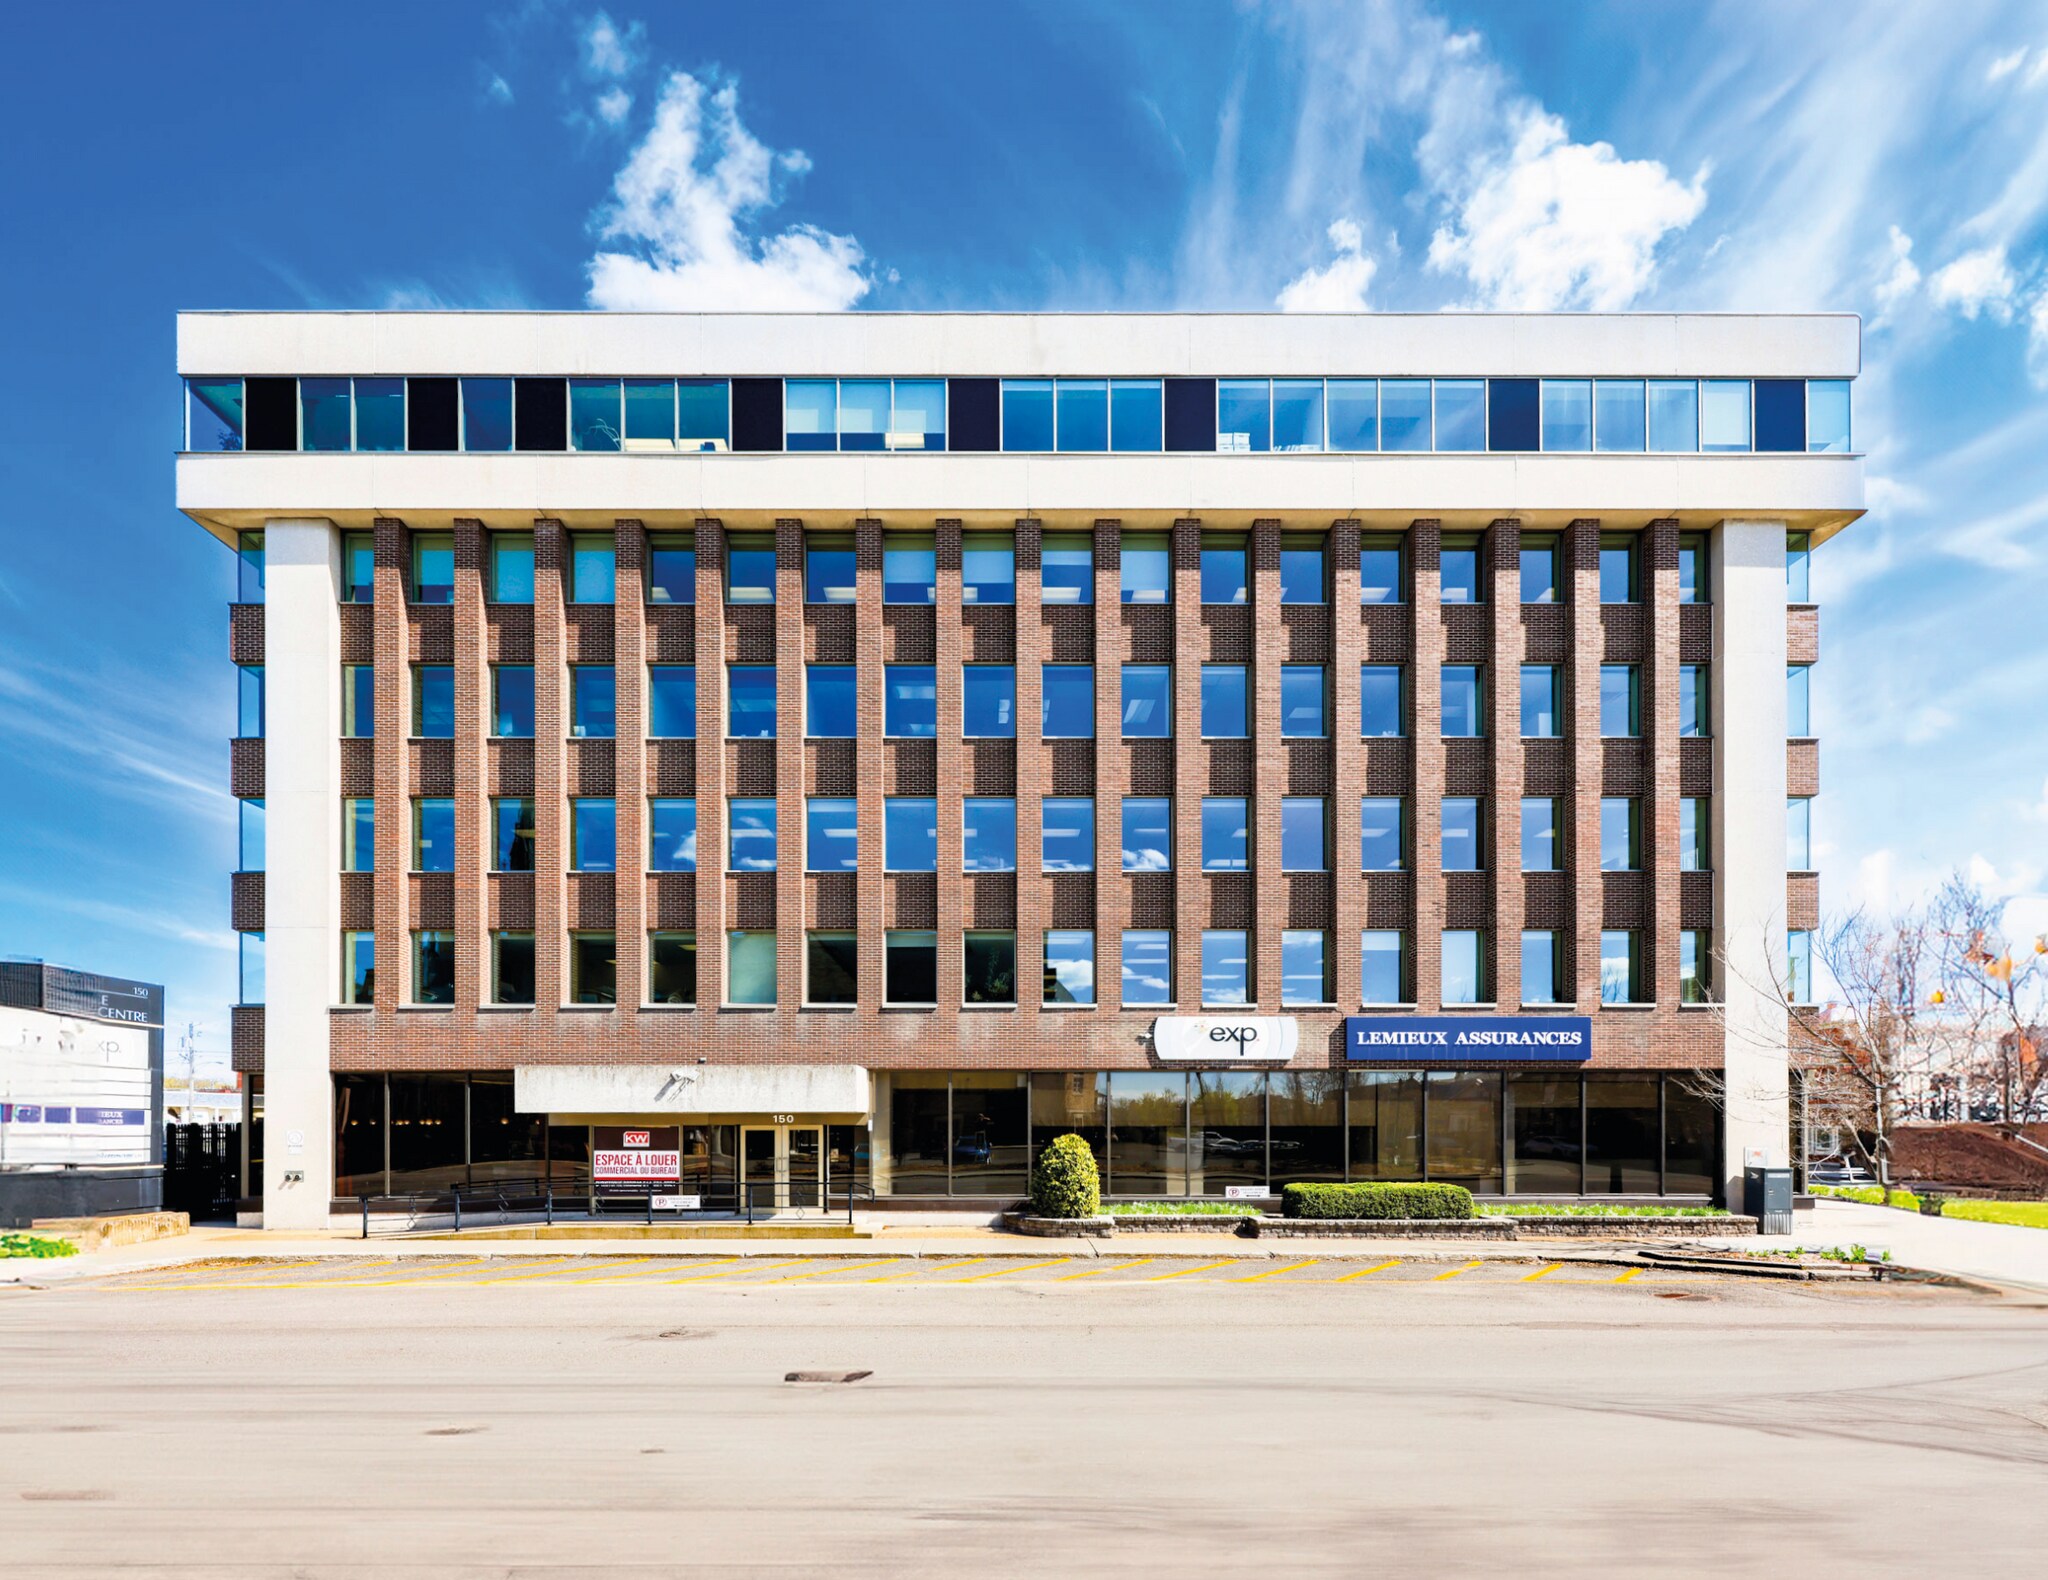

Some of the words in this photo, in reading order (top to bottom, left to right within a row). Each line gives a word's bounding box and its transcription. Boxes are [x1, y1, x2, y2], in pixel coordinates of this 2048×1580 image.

[133, 986, 149, 997] 150
[98, 1007, 148, 1023] CENTRE
[1356, 1031, 1448, 1045] LEMIEUX
[1454, 1031, 1583, 1045] ASSURANCES
[773, 1115, 795, 1123] 150
[625, 1134, 649, 1144] KW
[595, 1154, 633, 1166] ESPACE
[635, 1151, 643, 1166] À
[645, 1154, 678, 1166] LOUER
[594, 1166, 639, 1175] COMMERCIAL
[639, 1166, 650, 1175] OU
[650, 1166, 678, 1175] BUREAU
